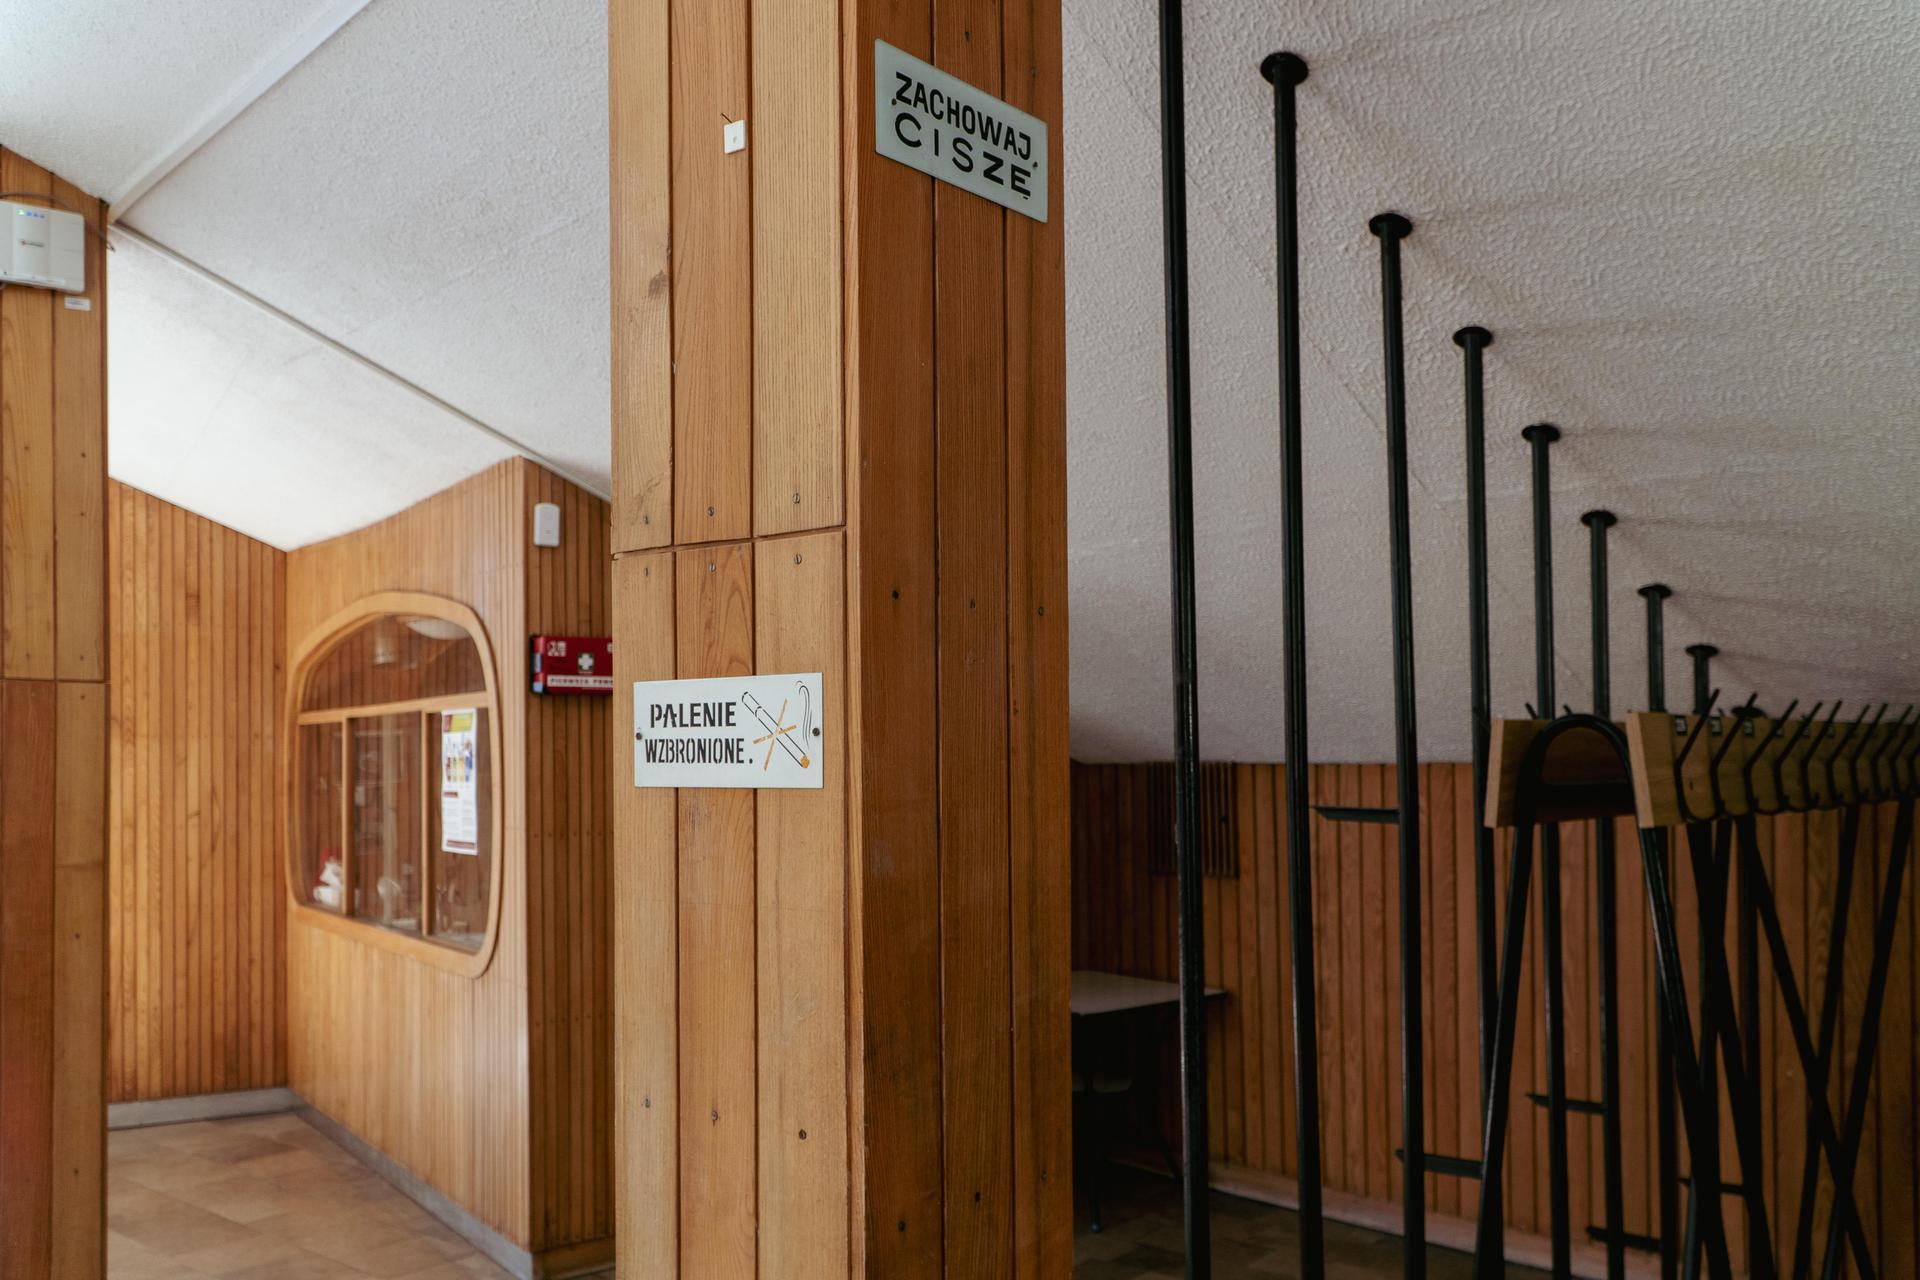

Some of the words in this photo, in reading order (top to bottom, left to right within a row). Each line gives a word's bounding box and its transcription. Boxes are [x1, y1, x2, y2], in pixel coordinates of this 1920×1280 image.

[895, 71, 1031, 161] ZACHOWAJ
[650, 701, 737, 728] PALENIE
[645, 738, 753, 764] WZBRONIONE.
